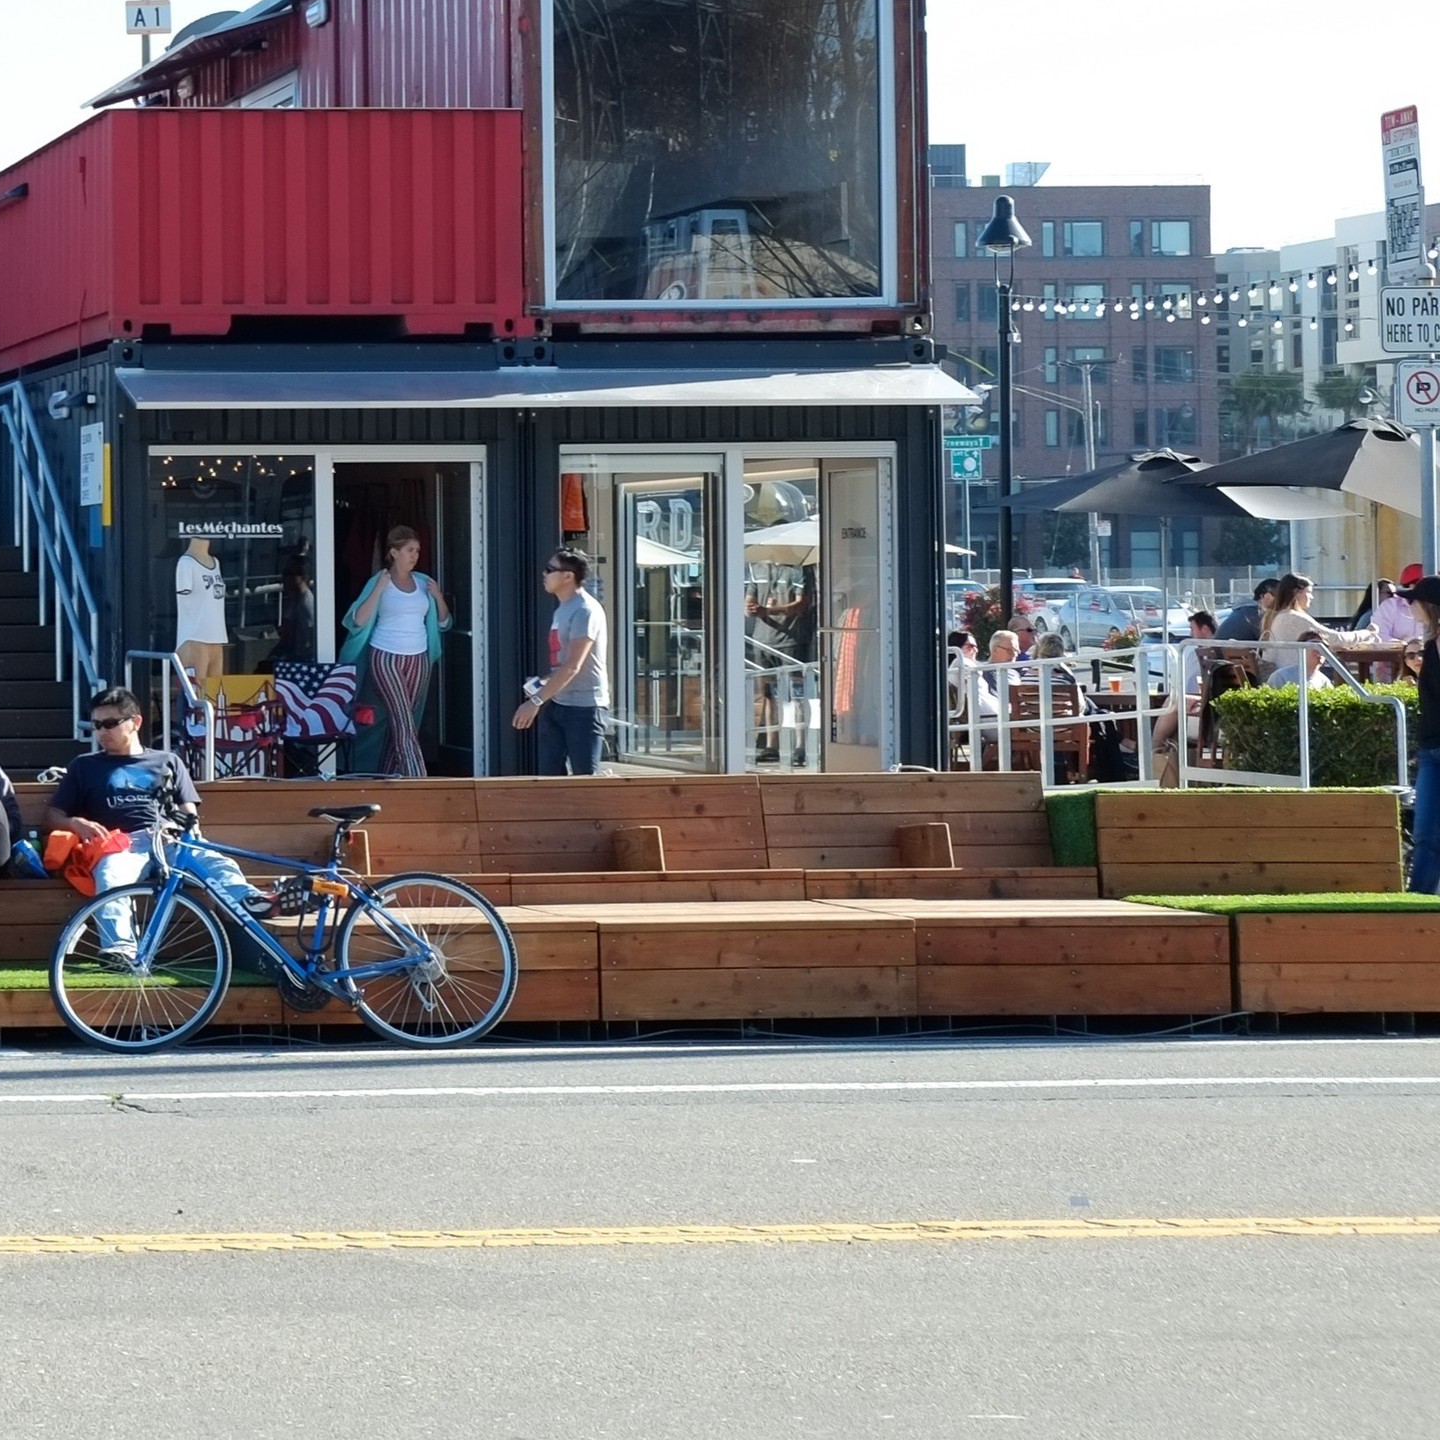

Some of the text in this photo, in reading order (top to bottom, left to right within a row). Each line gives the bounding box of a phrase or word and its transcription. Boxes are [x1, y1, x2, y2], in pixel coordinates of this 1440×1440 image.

[134, 6, 160, 27] A 1
[1386, 297, 1405, 316] NO
[1387, 324, 1413, 343] HERE
[1417, 324, 1430, 343] TO
[106, 795, 125, 808] US
[205, 877, 256, 923] GIANT
